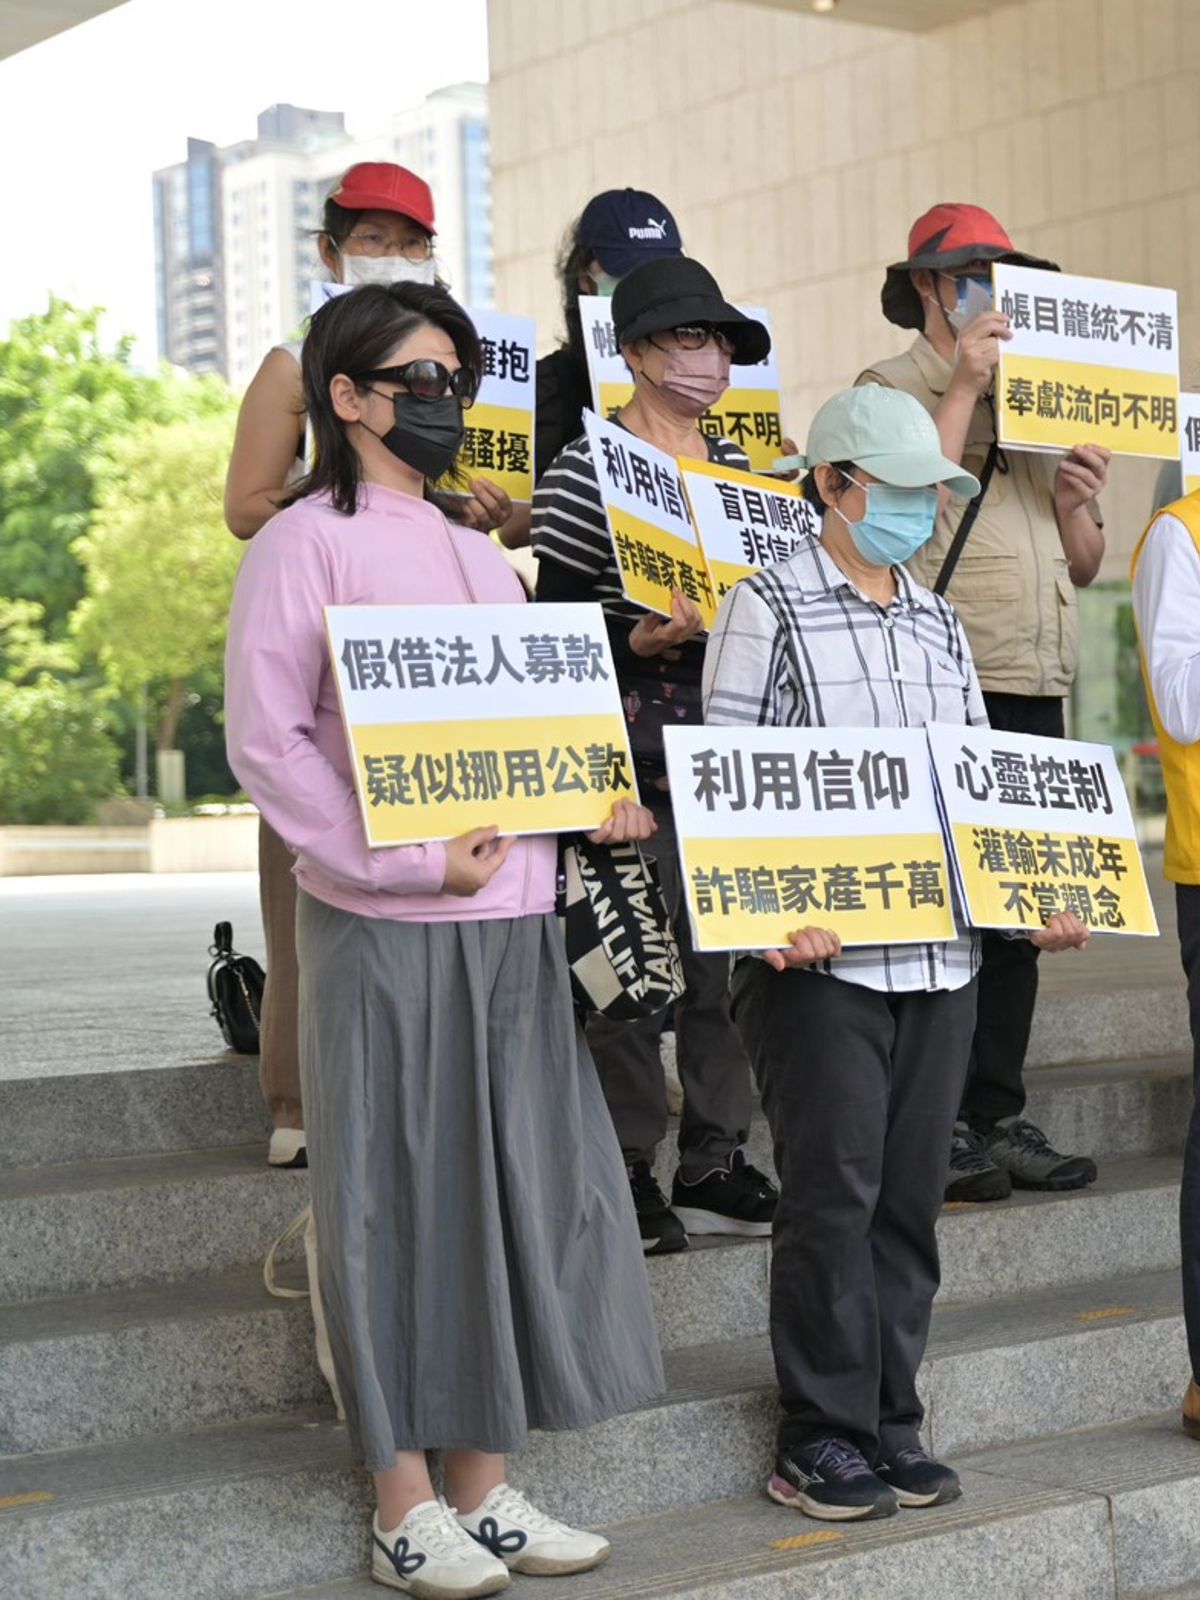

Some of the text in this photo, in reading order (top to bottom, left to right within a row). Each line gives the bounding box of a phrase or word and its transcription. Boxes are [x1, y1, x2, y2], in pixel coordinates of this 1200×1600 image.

[629, 226, 663, 240] PUMA
[1001, 290, 1174, 350] 帳目籠統不清
[1006, 377, 1177, 433] 奉獻流向不明
[715, 482, 818, 537] 盲目順從
[341, 634, 609, 690] 假借法人募款
[363, 743, 631, 806] 疑似挪用公款
[691, 749, 909, 811] 利用信仰
[955, 745, 1113, 815] 心靈控制
[972, 828, 1127, 881] 灌輸未成年
[692, 860, 944, 915] 詐騙家產千萬
[999, 881, 1126, 928] 不當觀念
